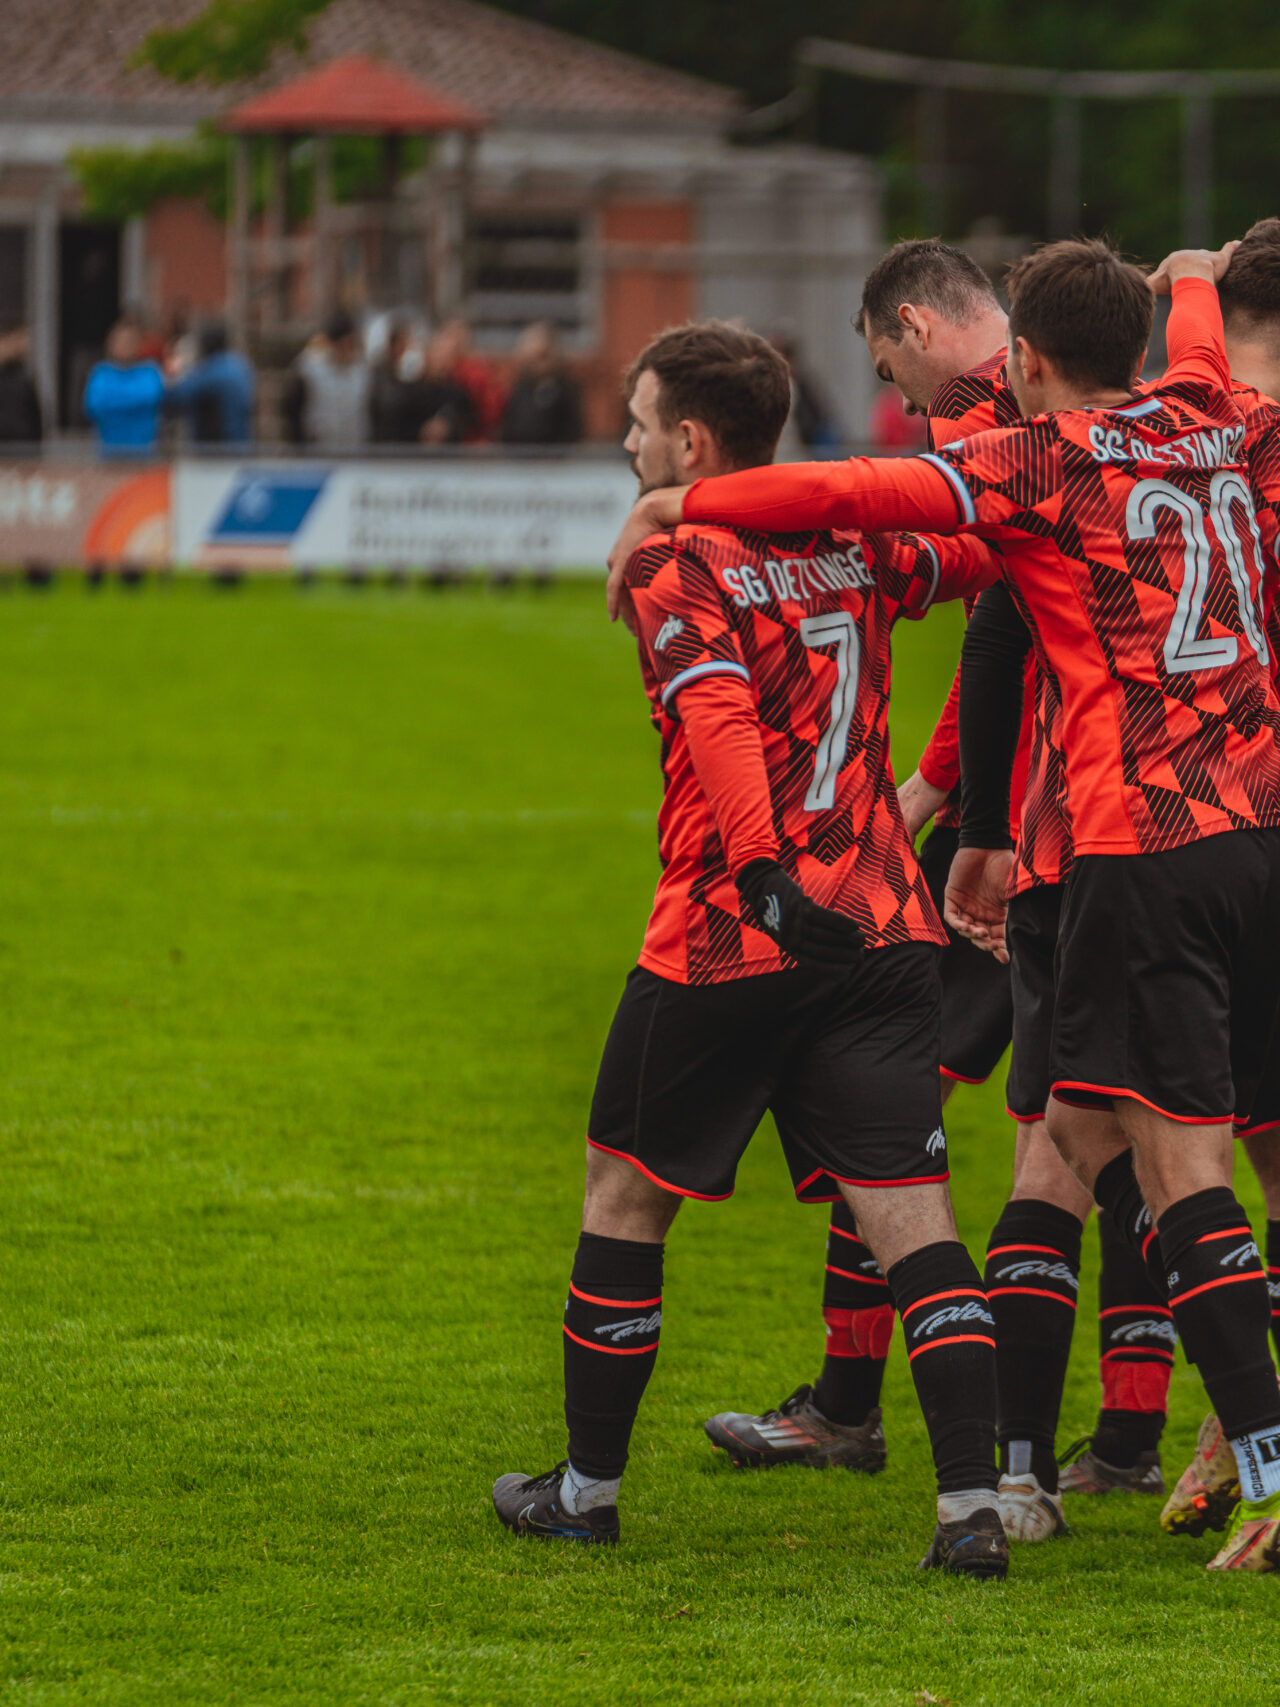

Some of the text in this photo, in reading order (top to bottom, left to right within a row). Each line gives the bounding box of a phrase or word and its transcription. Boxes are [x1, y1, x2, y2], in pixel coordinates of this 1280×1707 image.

[1088, 425, 1128, 462] SG
[722, 545, 877, 607] SG DETTINGE
[1126, 470, 1270, 674] 20
[800, 611, 860, 811] 7
